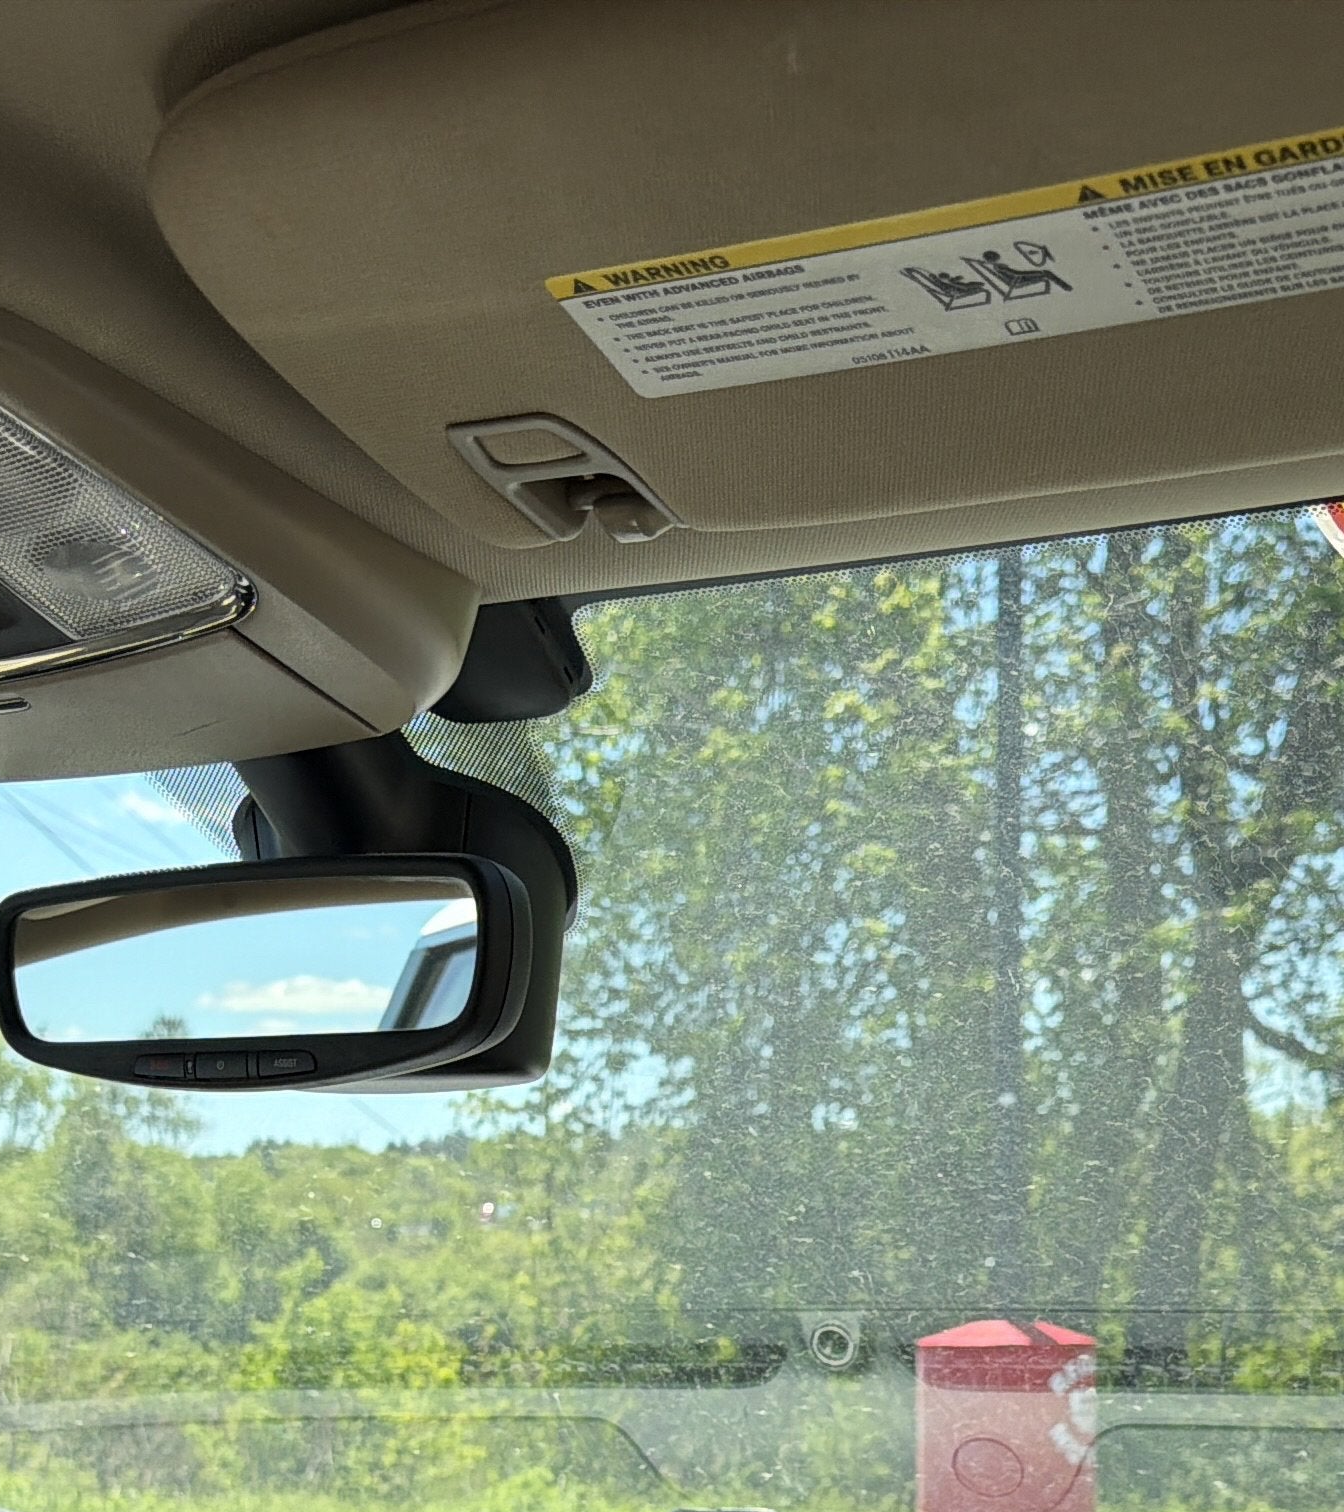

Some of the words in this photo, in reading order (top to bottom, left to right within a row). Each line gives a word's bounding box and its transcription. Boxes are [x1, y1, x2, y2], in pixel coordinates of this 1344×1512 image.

[1119, 163, 1198, 194] MISE
[1202, 155, 1248, 178] EN
[1136, 193, 1182, 209] AVEC
[1184, 186, 1219, 199] DES
[582, 296, 621, 308] EVEN
[621, 289, 660, 302] WITH
[661, 275, 740, 296] ADVANCED
[740, 264, 806, 282] AIRBAGS
[602, 254, 731, 288] WARNING
